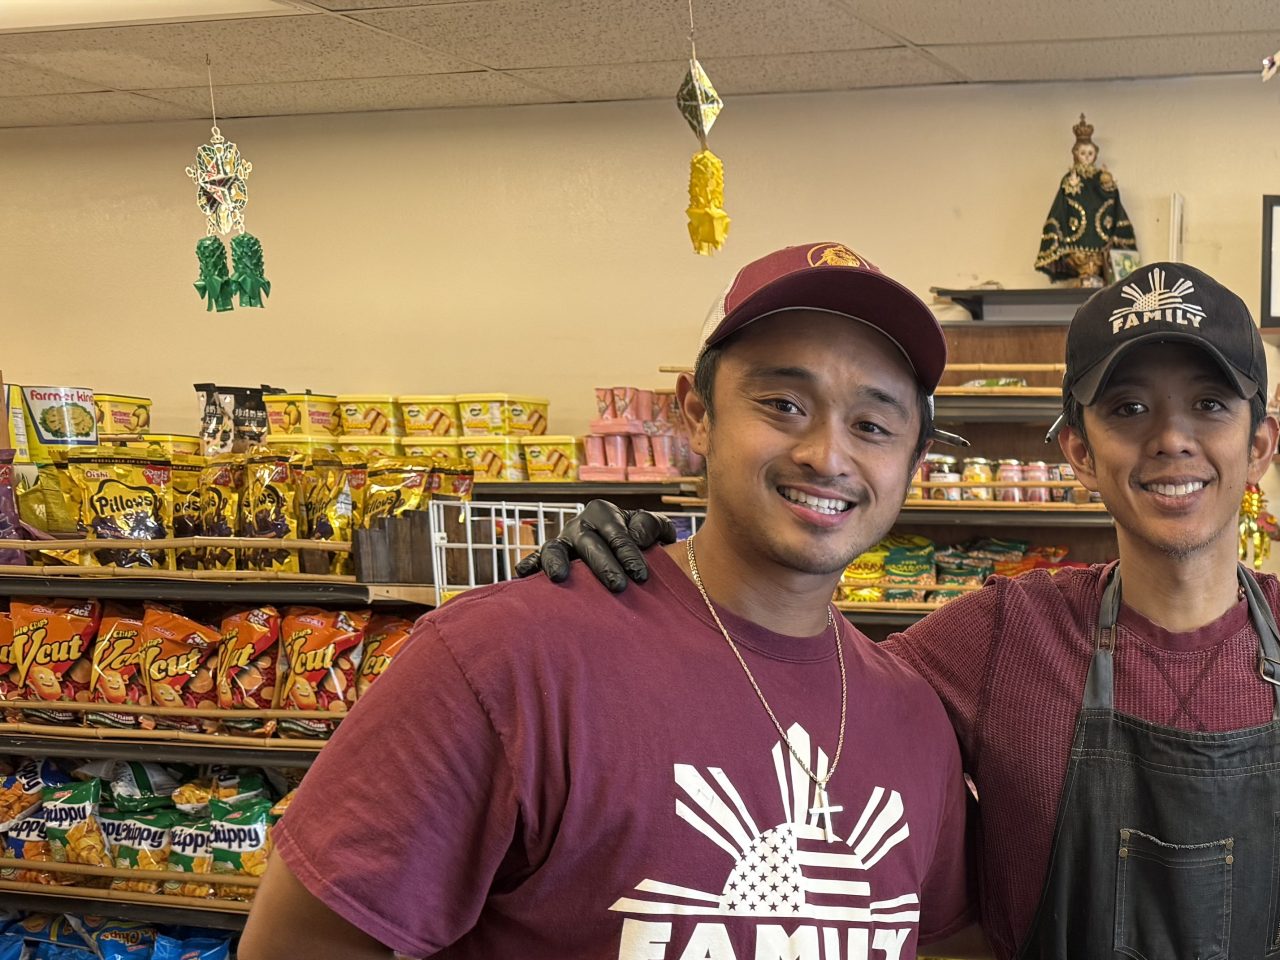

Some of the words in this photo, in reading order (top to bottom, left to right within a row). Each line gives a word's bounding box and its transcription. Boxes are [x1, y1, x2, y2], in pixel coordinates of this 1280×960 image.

[1112, 309, 1204, 335] FAMILY
[85, 470, 109, 479] Oishi
[95, 494, 153, 515] Pillows
